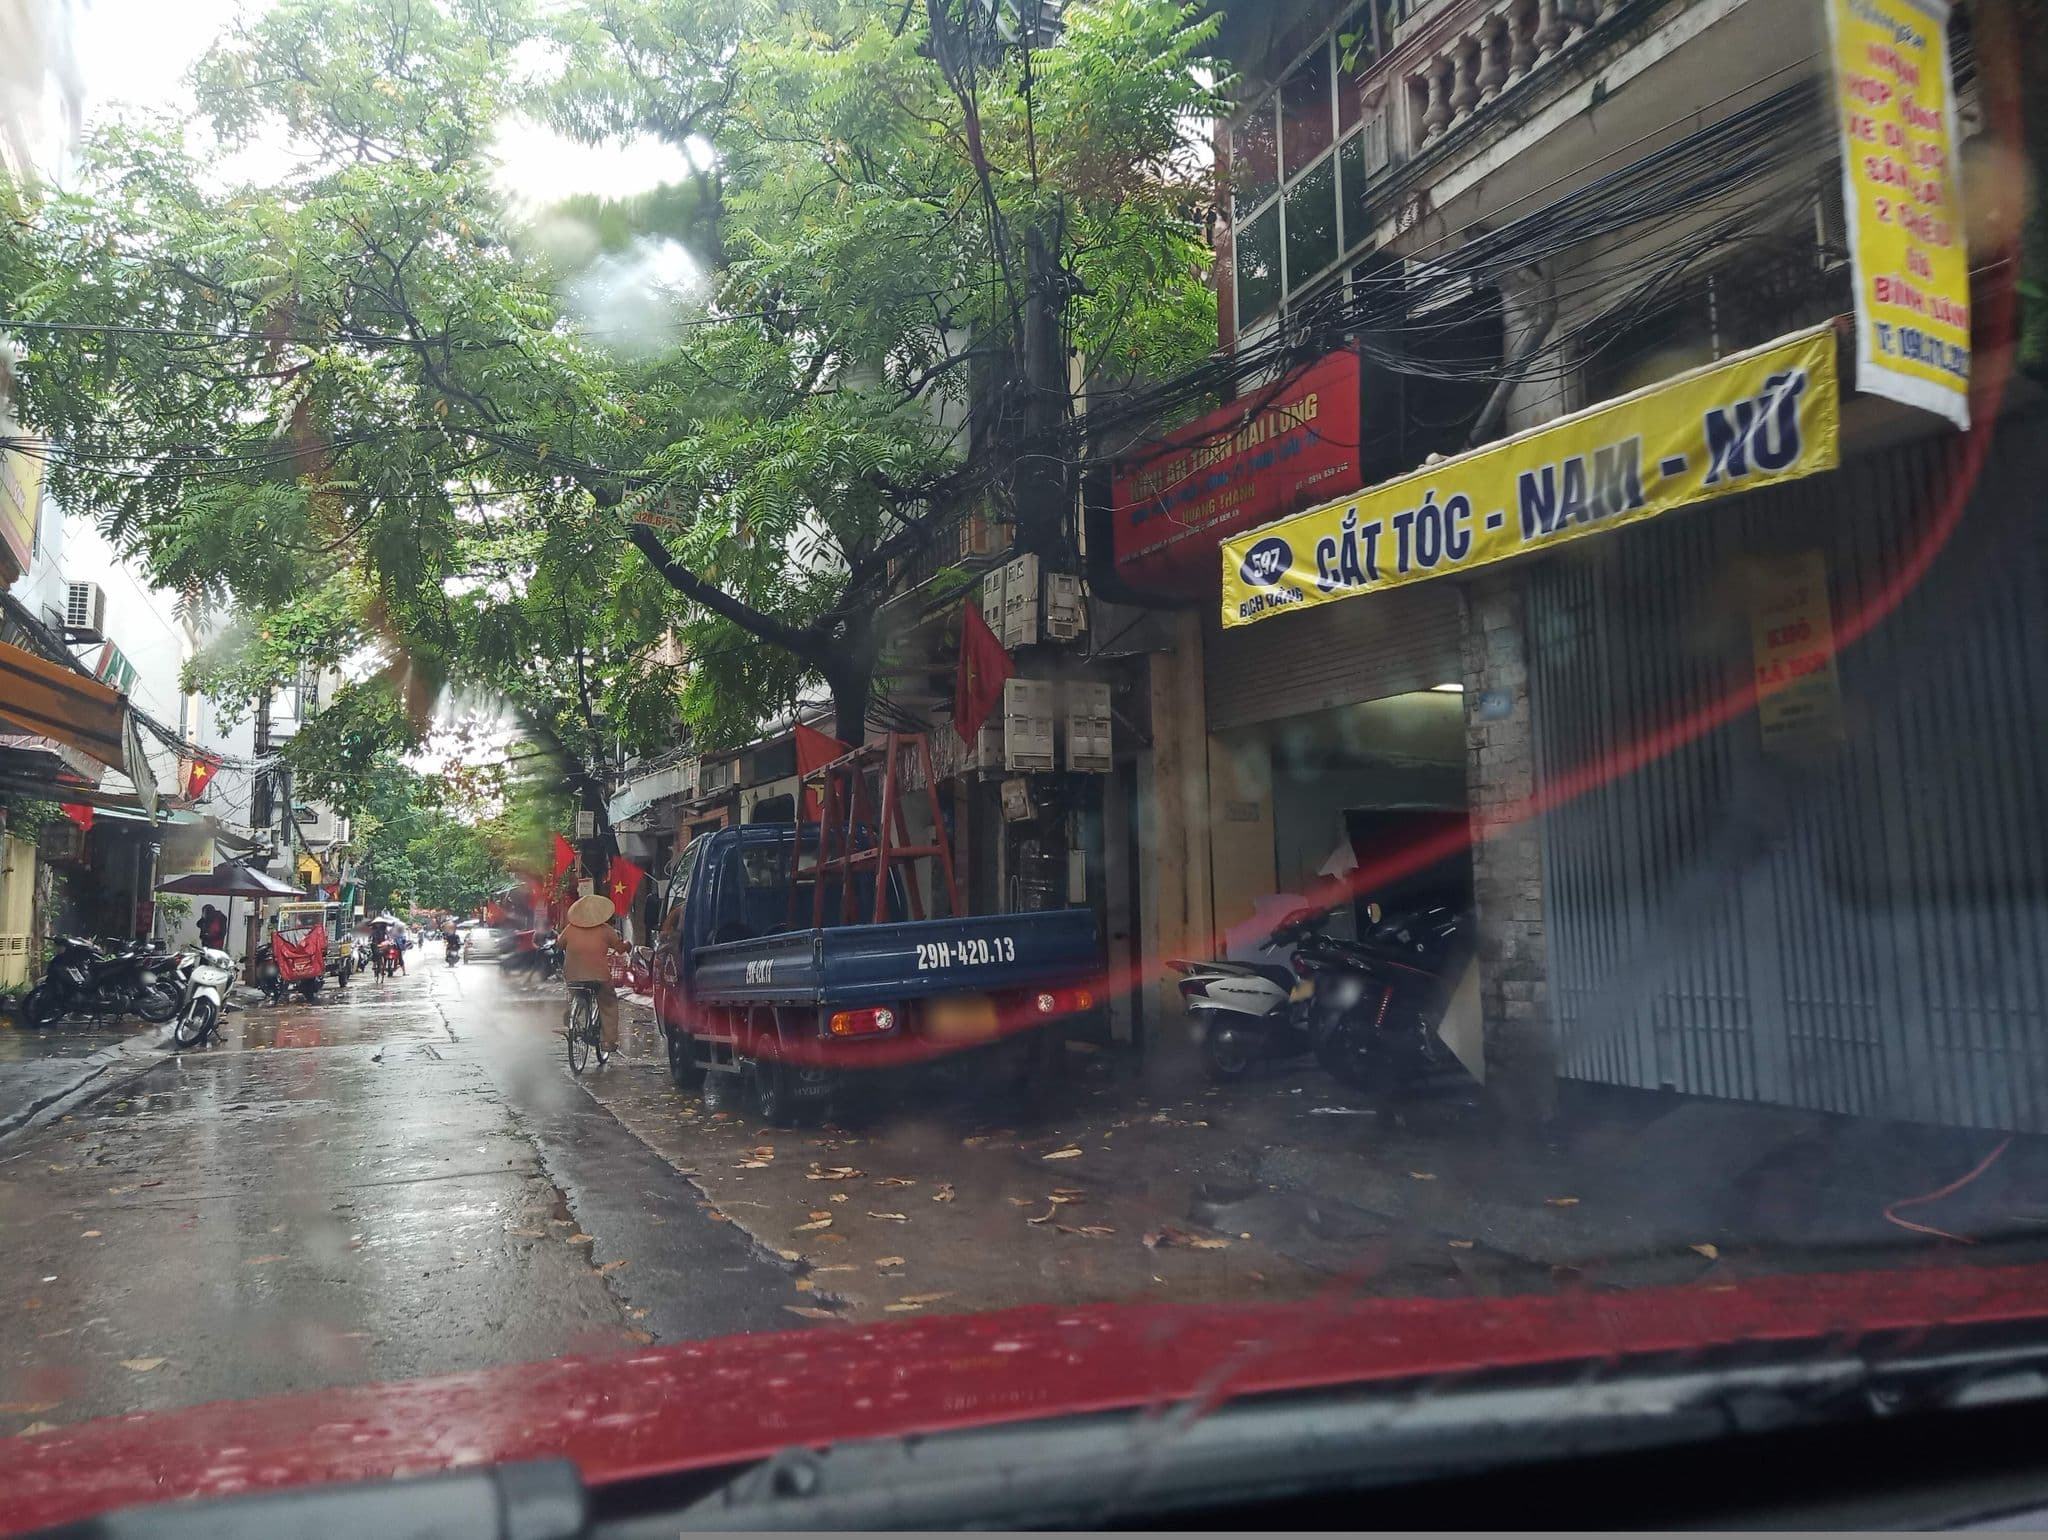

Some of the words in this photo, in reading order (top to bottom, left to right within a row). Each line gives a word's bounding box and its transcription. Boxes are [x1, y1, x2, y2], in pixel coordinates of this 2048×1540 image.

[1317, 507, 1382, 592] CẮT
[1393, 491, 1471, 573] TÓC
[1519, 436, 1644, 540] NAM
[1704, 368, 1807, 485] NỮ
[1251, 547, 1281, 578] 597
[917, 936, 1016, 970] 29H-420.13
